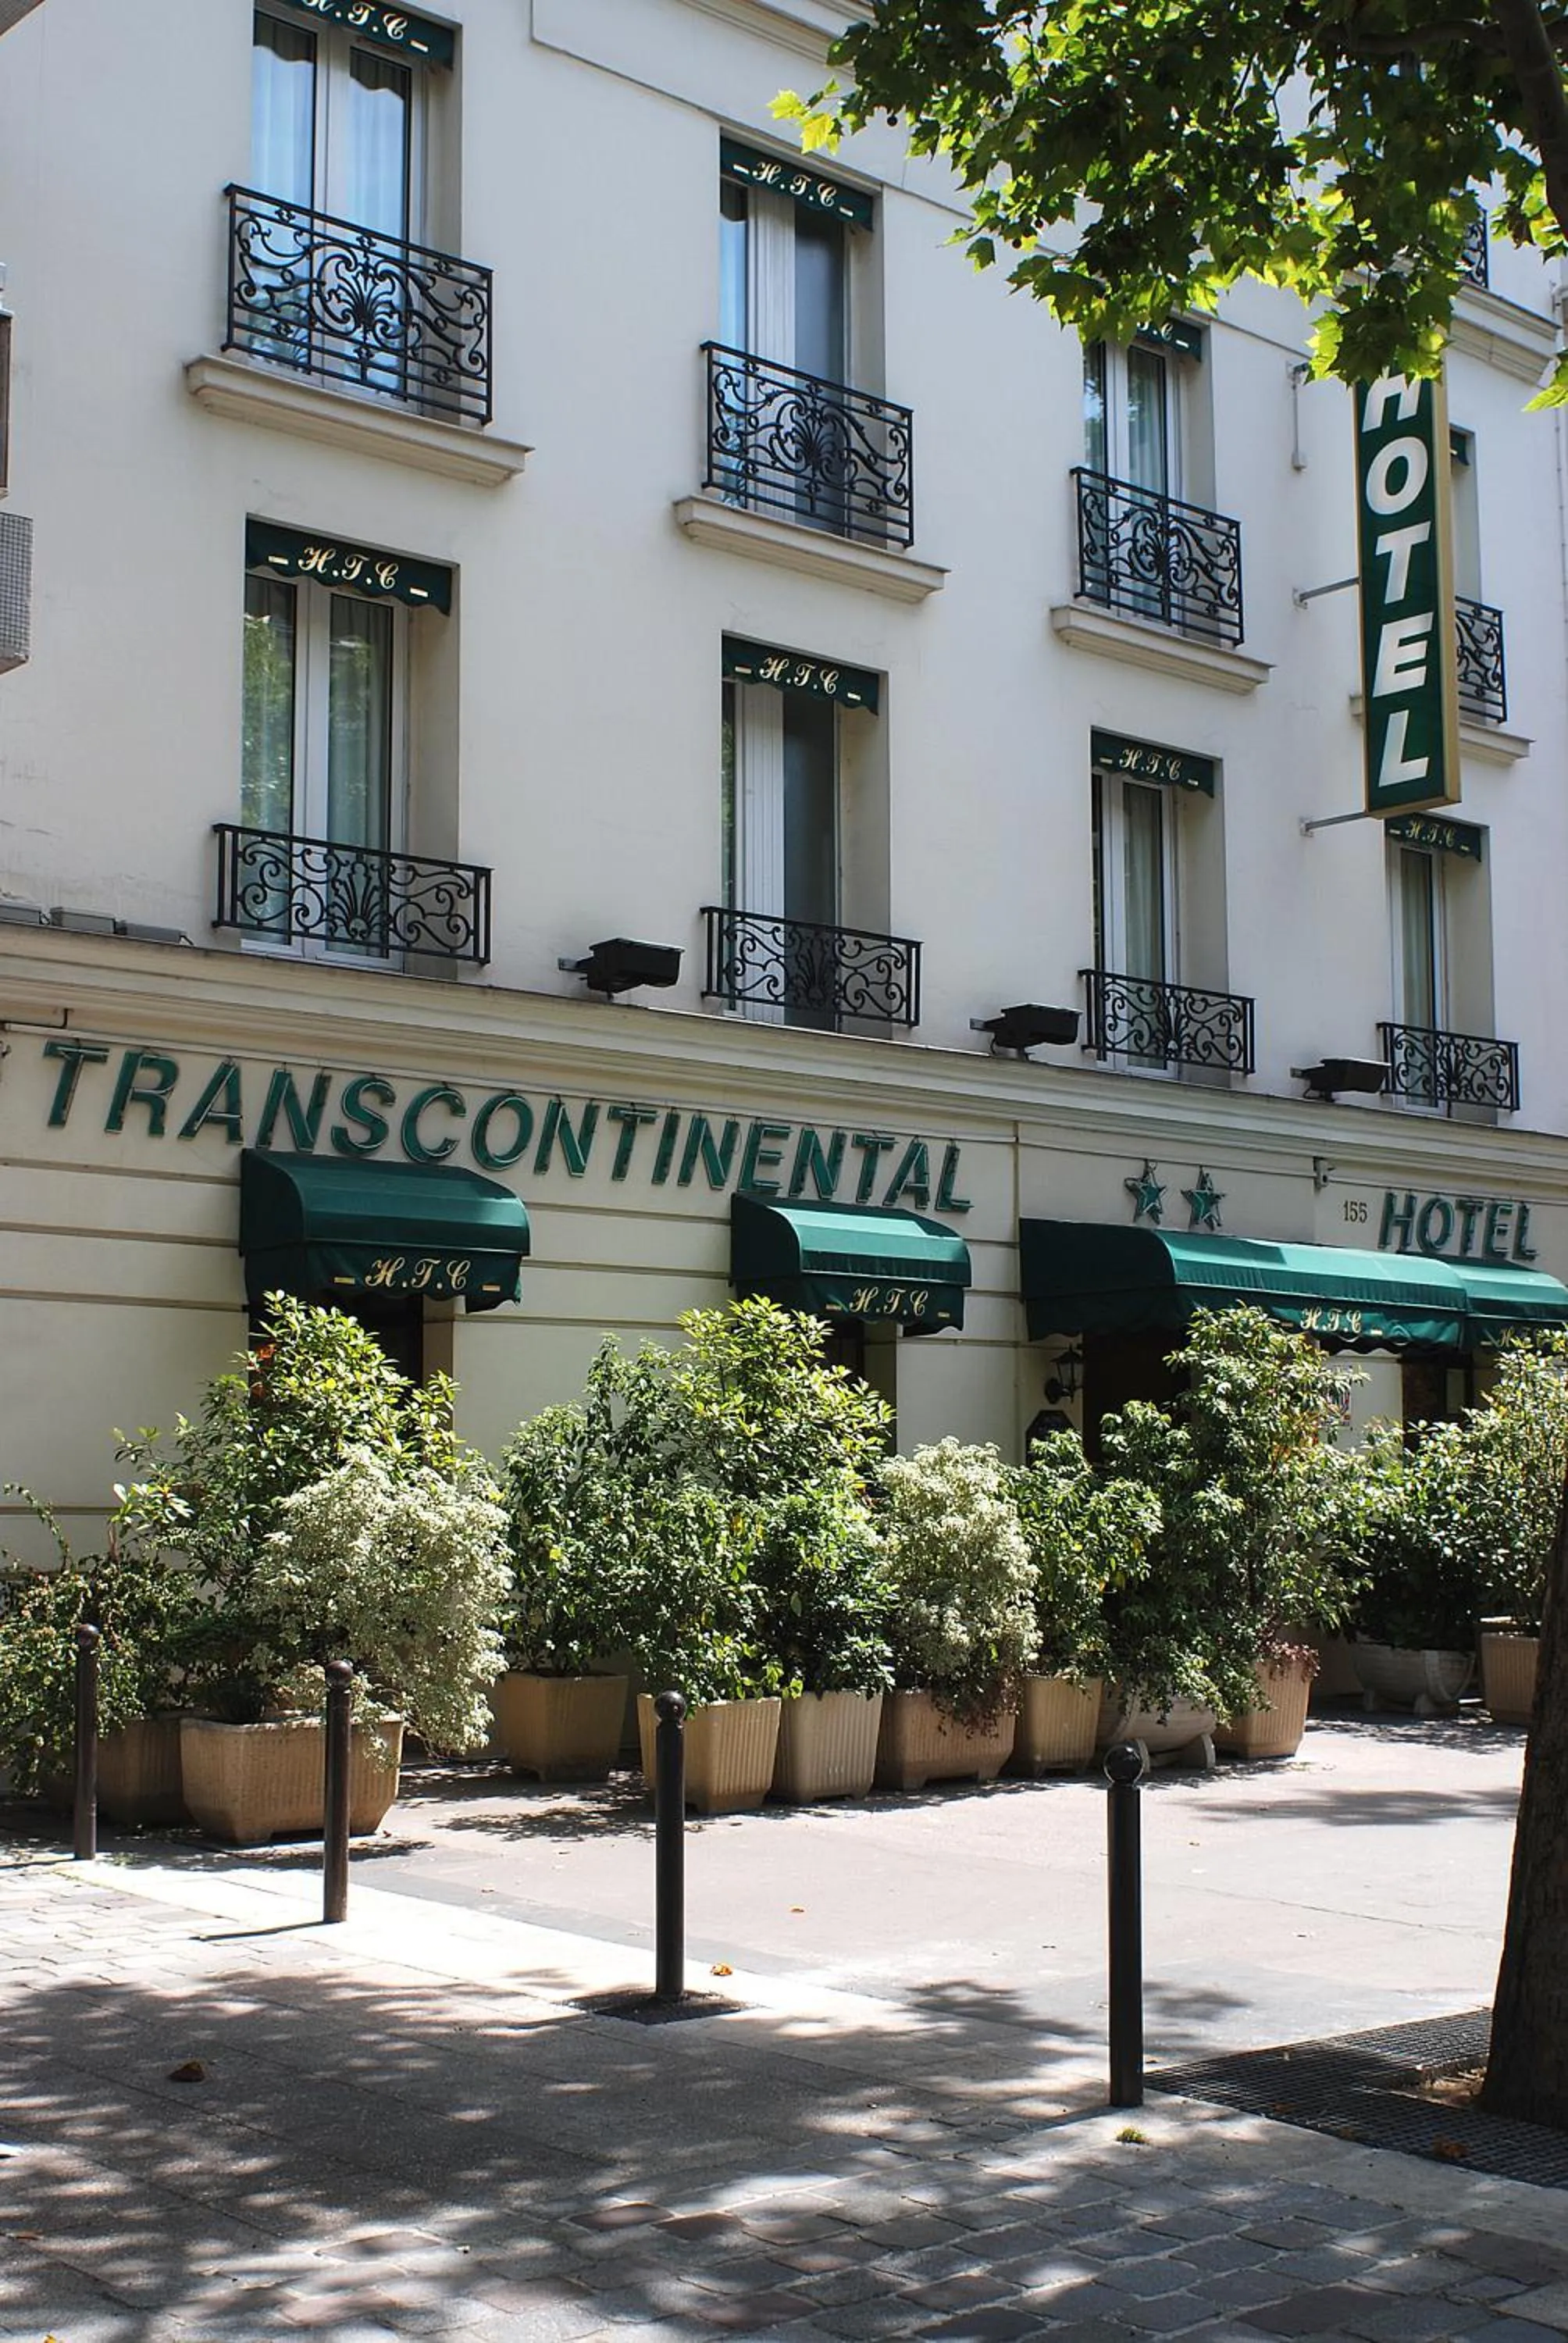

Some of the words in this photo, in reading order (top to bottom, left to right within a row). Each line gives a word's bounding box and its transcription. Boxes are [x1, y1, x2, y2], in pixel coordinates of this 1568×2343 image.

[42, 1040, 975, 1212] TRANSCONTINENTAL
[1342, 1200, 1367, 1223] 155
[1377, 1191, 1540, 1261] HOTEL
